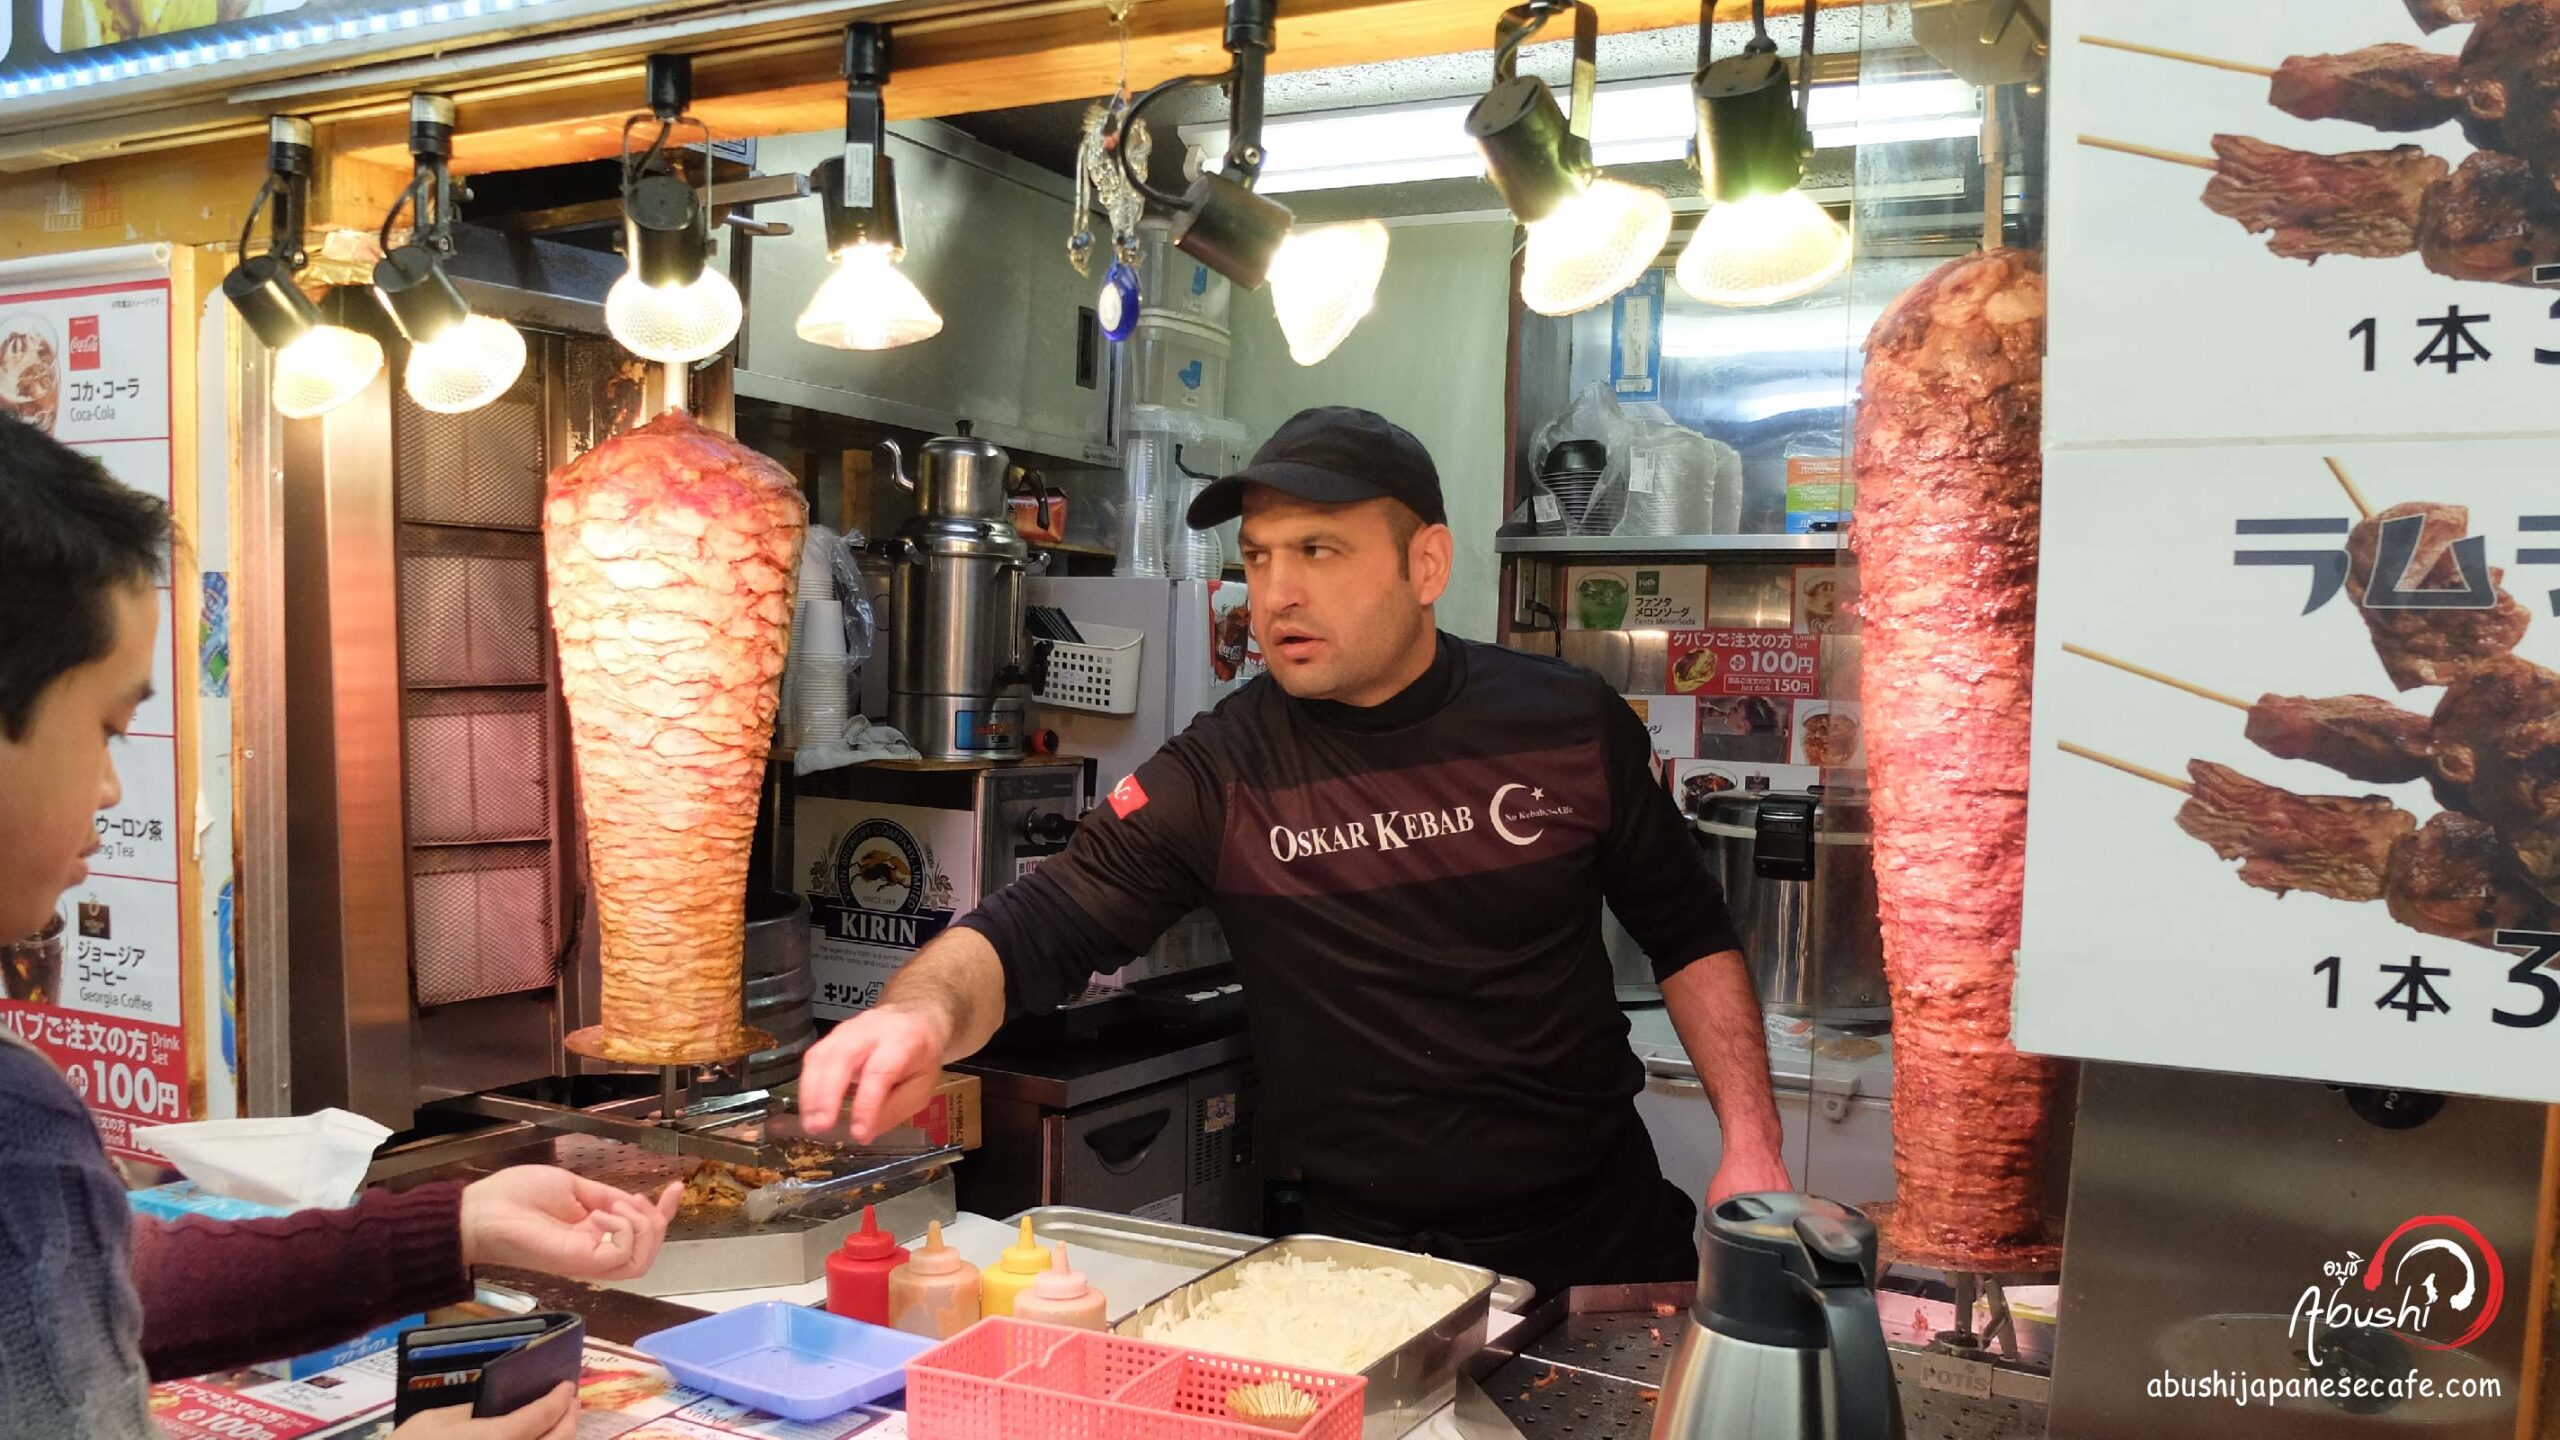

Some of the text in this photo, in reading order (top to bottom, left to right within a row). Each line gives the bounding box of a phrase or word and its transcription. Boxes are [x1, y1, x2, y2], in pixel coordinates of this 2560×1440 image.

[70, 378, 139, 402] コカ・コーラ
[70, 404, 116, 422] Coca-Cola
[1635, 597, 1672, 608] ファンタ
[1635, 606, 1690, 618] メロンソーダ
[1673, 632, 1793, 649] ケバブご注文の方
[1795, 641, 1808, 649] Set
[1750, 650, 1814, 674] 100円
[1774, 678, 1810, 693] 150円
[96, 815, 163, 841] ウーロン茶
[1270, 806, 1475, 863] OSKAR KEBAB
[116, 842, 135, 858] Tea
[907, 863, 922, 910] LIMITED
[840, 912, 917, 945] KIRIN
[78, 941, 145, 967] ジョージア
[79, 964, 128, 987] コーヒー
[79, 987, 154, 1011] Georgia Coffee
[0, 1009, 148, 1062] バブご注文の方
[151, 1031, 180, 1052] Drink
[151, 1050, 168, 1066] Set
[93, 1060, 179, 1119] 100円
